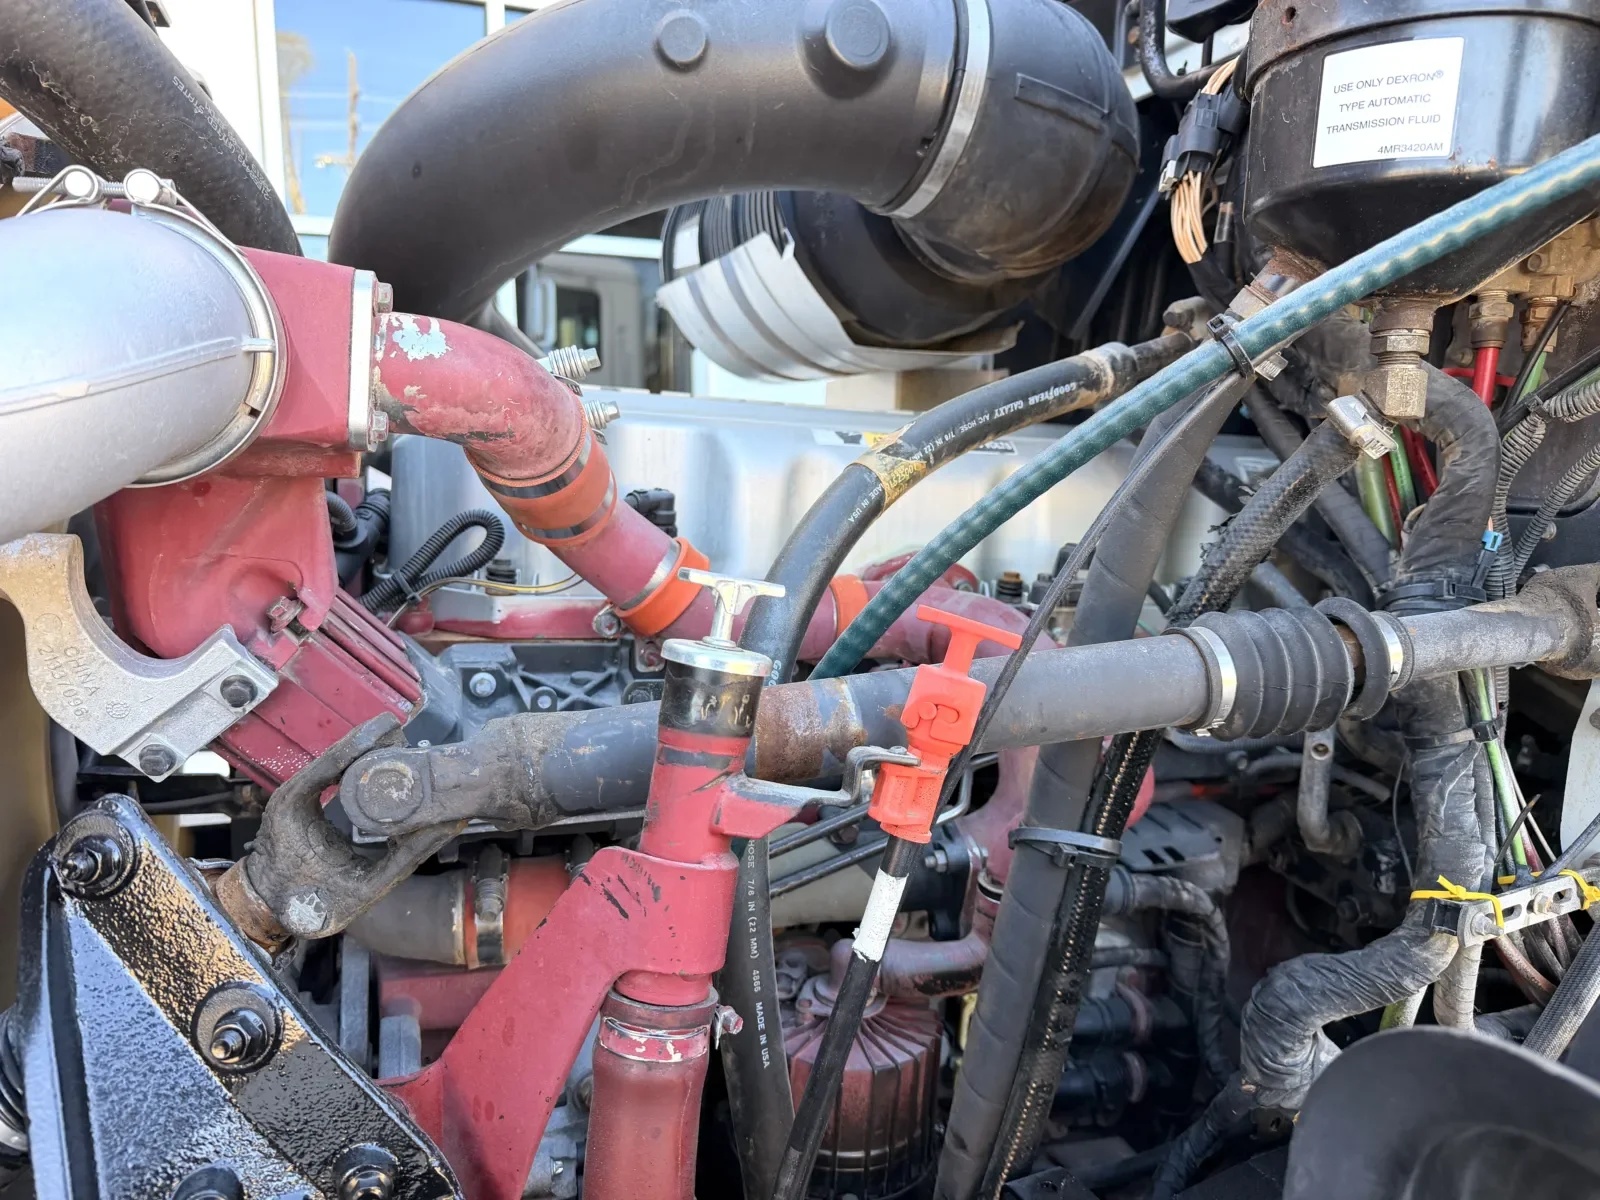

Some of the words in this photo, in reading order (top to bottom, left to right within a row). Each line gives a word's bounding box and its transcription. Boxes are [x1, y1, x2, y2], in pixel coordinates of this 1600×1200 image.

[1333, 82, 1354, 94] USE
[1356, 77, 1384, 90] ONLY
[172, 75, 205, 114] STATES
[1339, 100, 1365, 113] TYPE
[1367, 93, 1432, 108] AUTOMATIC
[1326, 117, 1405, 134] TRANSMISSION
[1408, 113, 1441, 125] FLUID
[1377, 142, 1443, 154] 4MR3420AM
[1028, 381, 1077, 406] GOODYEAR
[994, 399, 1024, 418] GALAXY
[960, 419, 977, 434] HOSE
[978, 413, 990, 424] A/C
[935, 436, 944, 447] IN
[944, 430, 956, 443] 7/8
[861, 497, 870, 508] IN
[848, 508, 862, 523] USA
[63, 645, 100, 697] CHINA
[38, 645, 90, 718] 21337096
[747, 838, 755, 869] HOSE
[747, 879, 756, 896] 7/8
[747, 901, 756, 912] IN
[748, 916, 757, 933] (22
[749, 937, 759, 960] MM)
[755, 1002, 765, 1030] MADE
[759, 1033, 768, 1045] IN
[761, 1046, 771, 1069] USA
